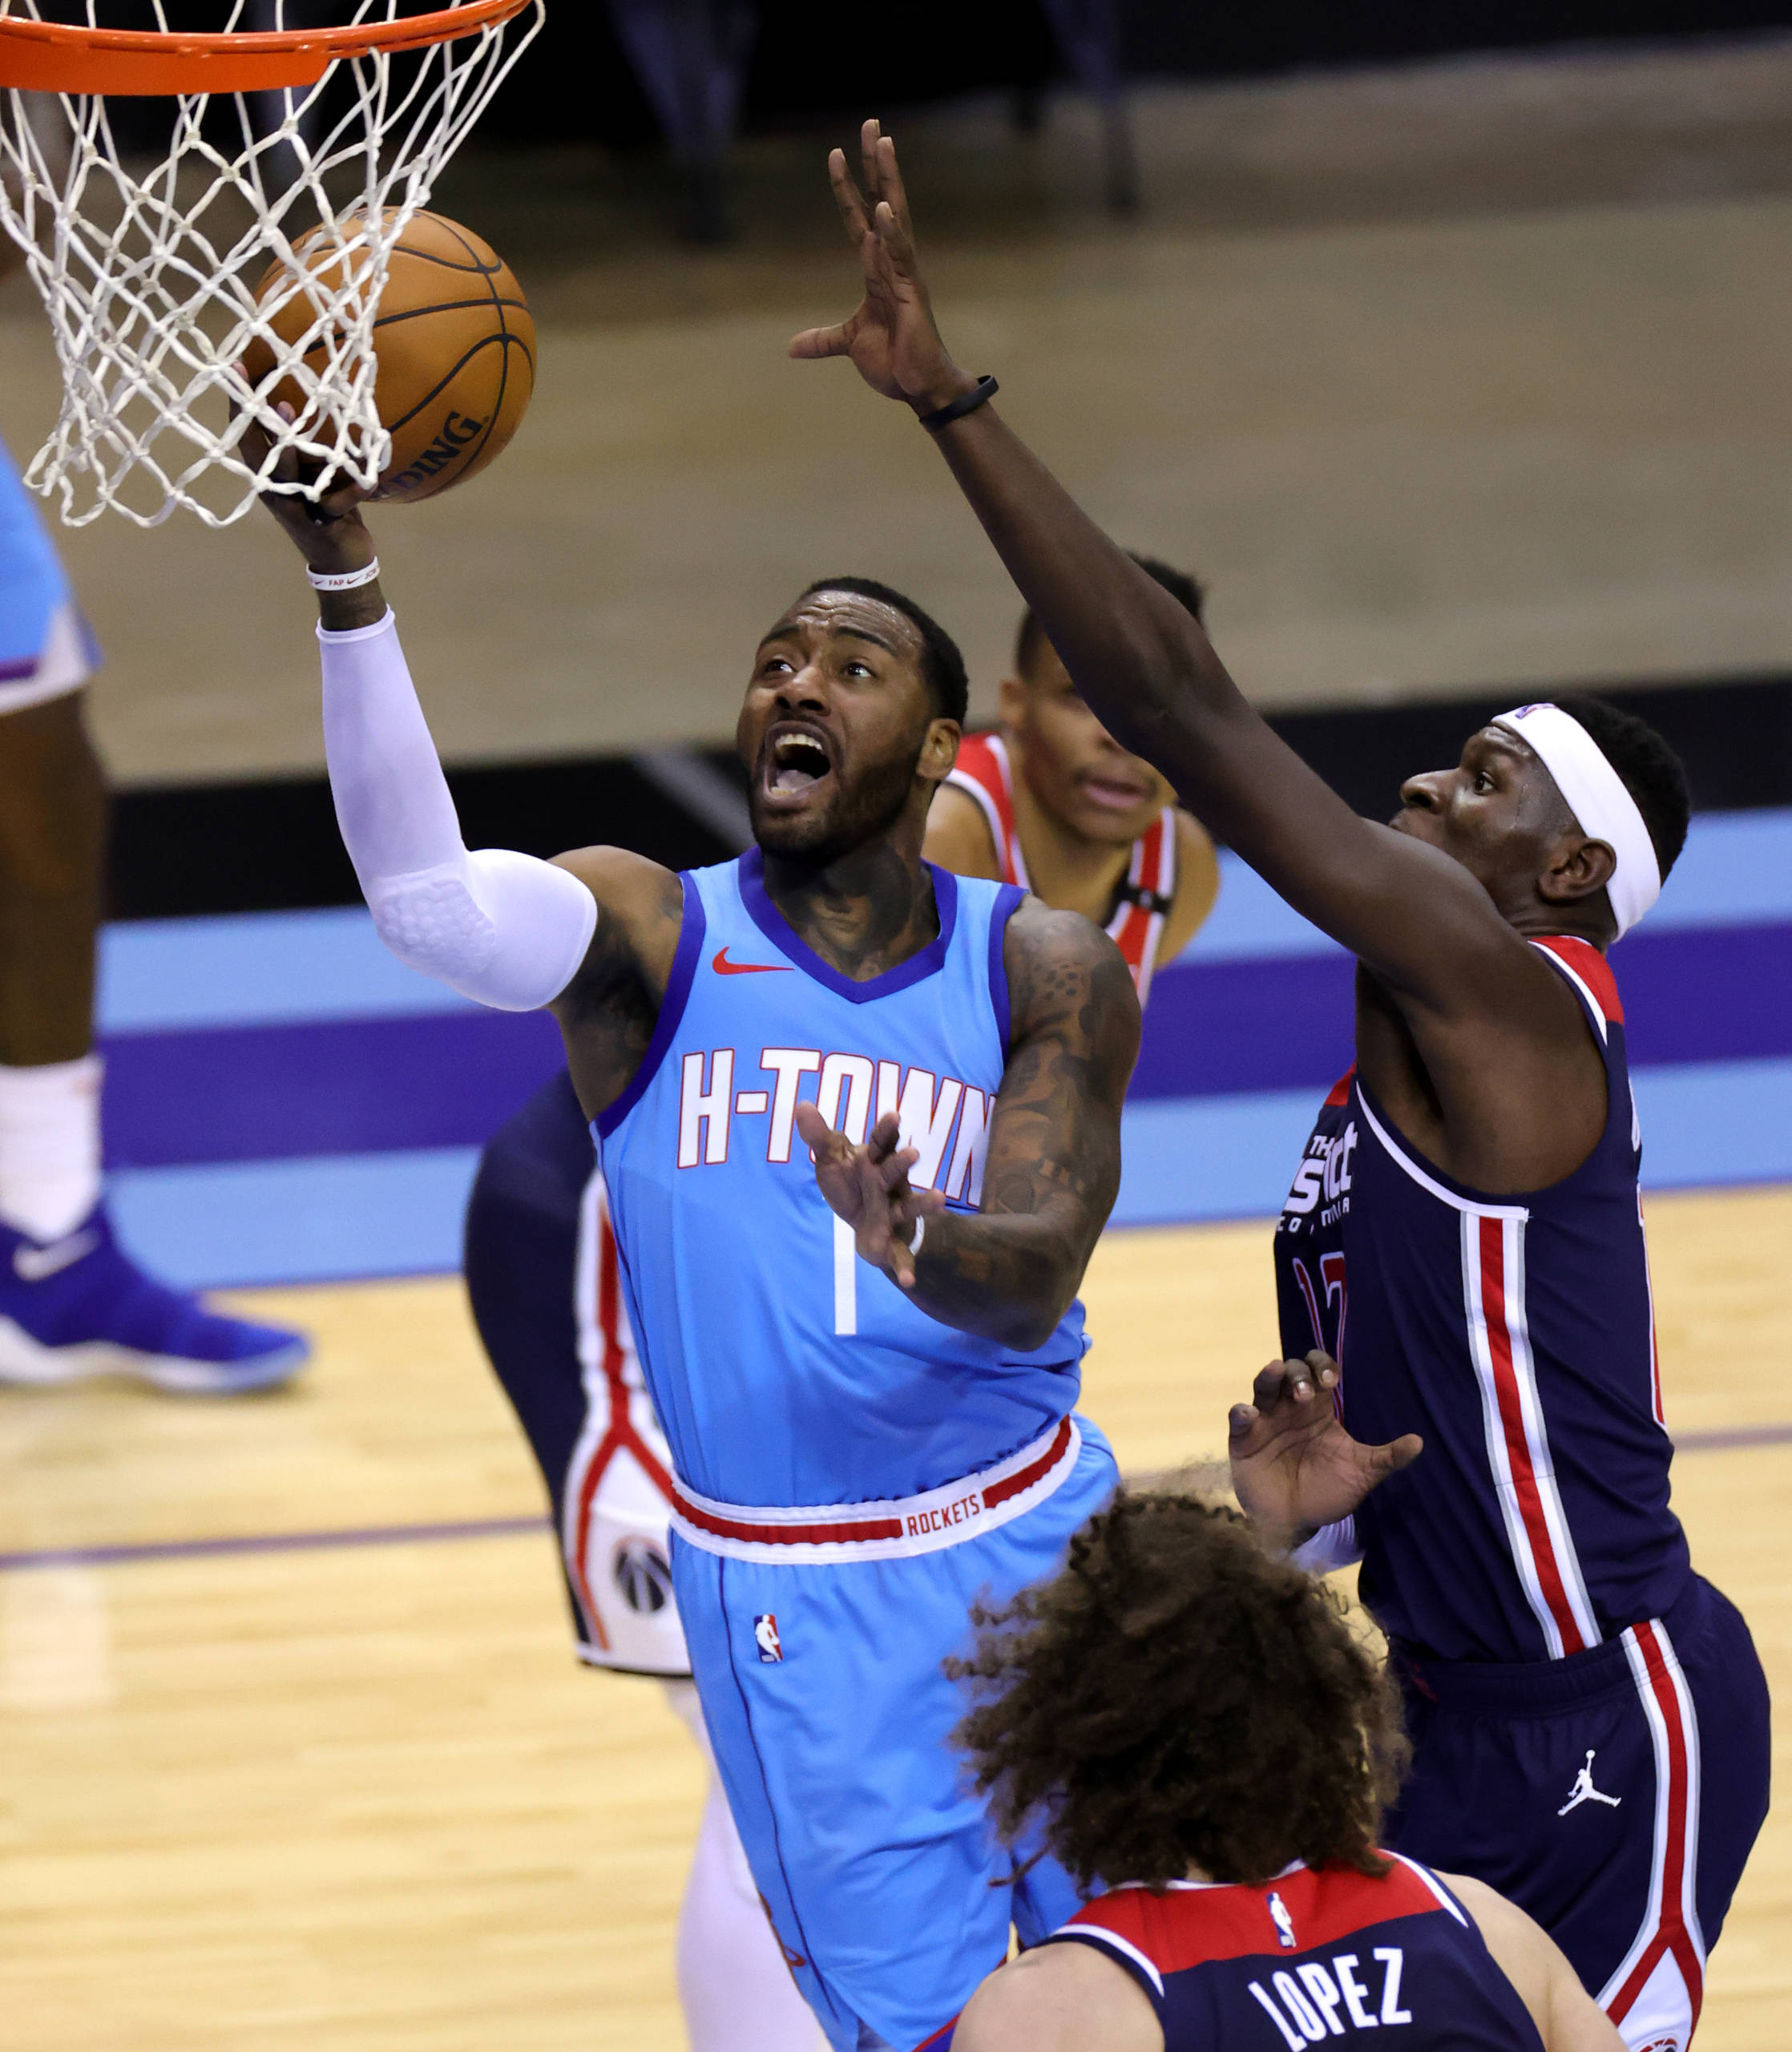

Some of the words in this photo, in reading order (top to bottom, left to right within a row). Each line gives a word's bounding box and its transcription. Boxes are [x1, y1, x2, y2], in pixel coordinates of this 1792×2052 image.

[677, 1048, 997, 1207] H-TOWN
[1309, 1134, 1335, 1156] TH
[831, 1206, 857, 1335] 1
[906, 1494, 980, 1537] ROCKETS
[1247, 1947, 1413, 2052] LOPEZ
